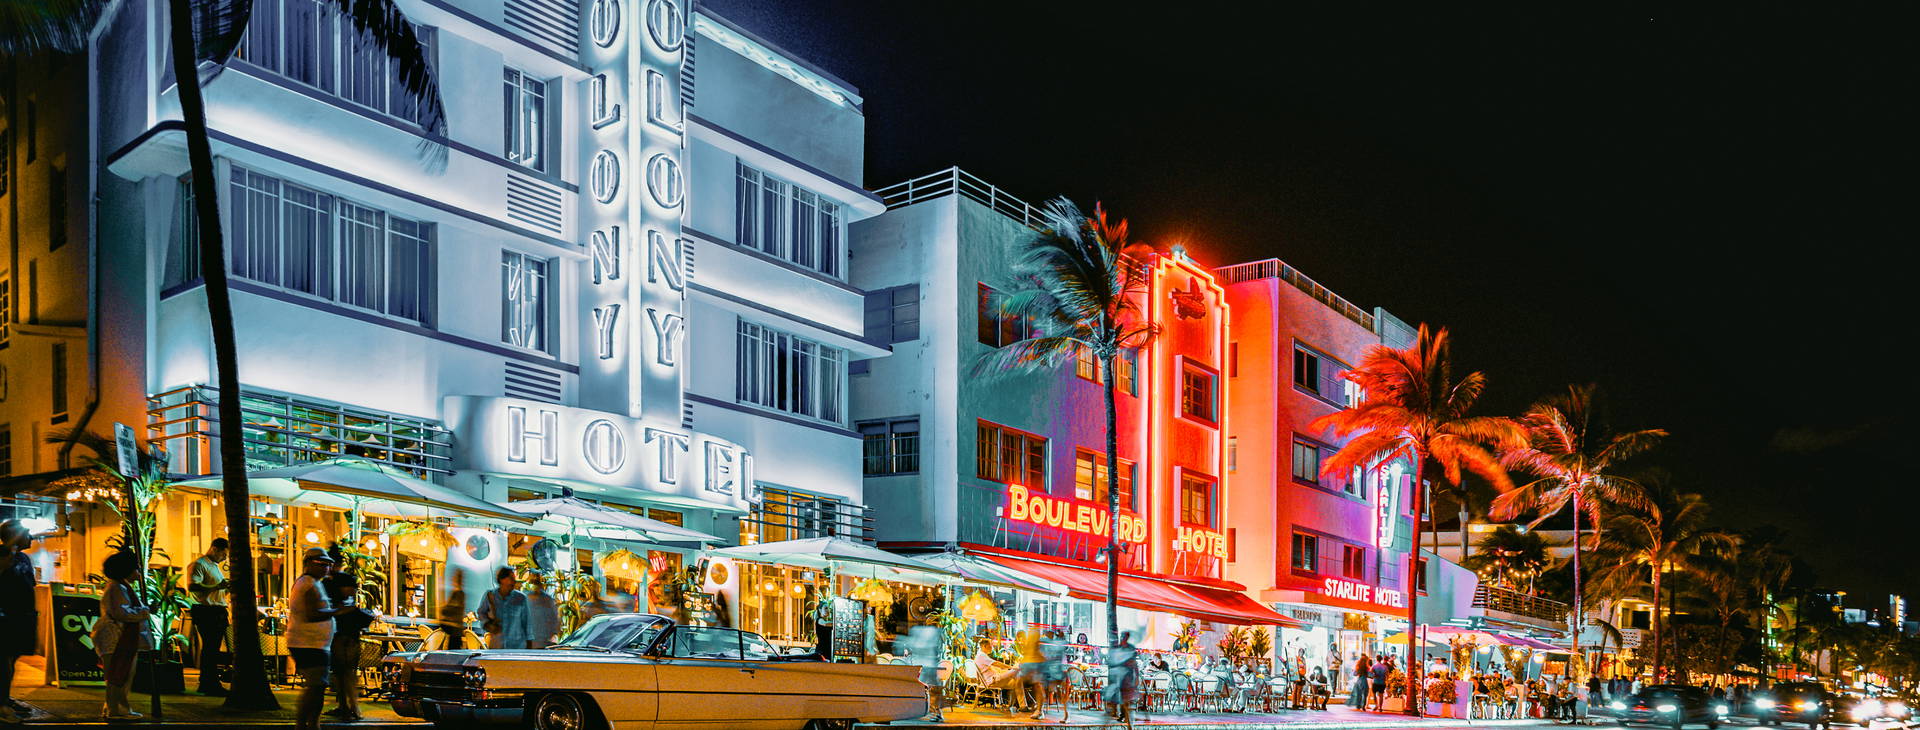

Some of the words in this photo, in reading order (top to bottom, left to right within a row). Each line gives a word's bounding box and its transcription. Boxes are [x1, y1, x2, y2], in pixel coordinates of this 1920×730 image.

[507, 406, 761, 503] HOTEL
[1378, 465, 1391, 548] STARLITE
[1177, 526, 1229, 559] HOTEL
[1325, 578, 1370, 602] STARLITE
[1375, 587, 1403, 608] HOTEL
[61, 671, 85, 679] Open
